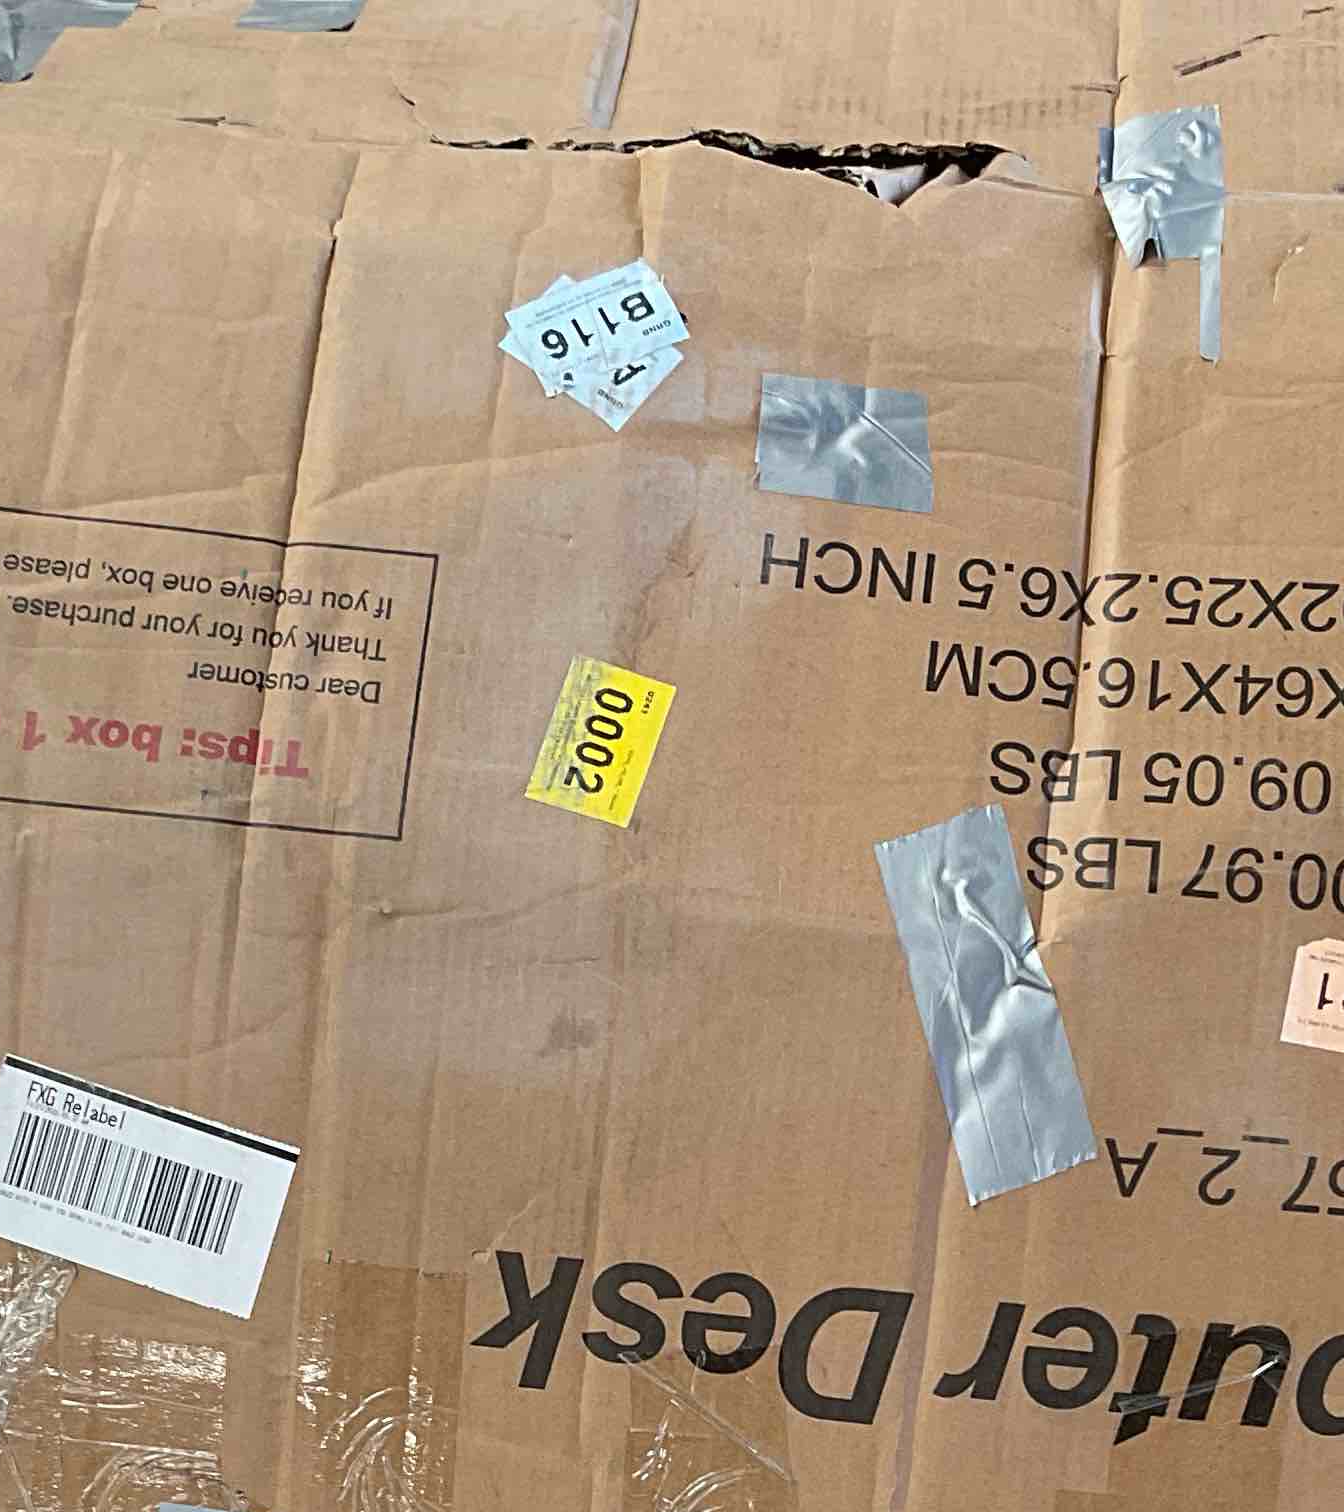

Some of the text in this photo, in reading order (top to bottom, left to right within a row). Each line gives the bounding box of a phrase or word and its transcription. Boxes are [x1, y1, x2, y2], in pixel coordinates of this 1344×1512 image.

[541, 291, 655, 359] B116
[3, 550, 91, 584] please
[101, 563, 154, 593] box,
[162, 573, 211, 596] one
[760, 533, 936, 606] INCH
[6, 594, 135, 632] purchase.
[221, 582, 313, 609] receive
[321, 589, 368, 612] you
[373, 597, 393, 620] If
[141, 613, 200, 638] your
[208, 621, 243, 647] for
[252, 625, 296, 647] you
[306, 632, 386, 661] Thank
[187, 662, 381, 705] Dear customer
[21, 711, 45, 751] 1
[64, 714, 163, 763] box
[564, 688, 633, 793] 0002
[176, 728, 309, 780] Tips:
[988, 741, 1120, 803] LBS
[1026, 836, 1161, 896] LBS
[27, 1080, 58, 1107] FXG
[63, 1092, 127, 1130] Relabel
[468, 1247, 913, 1428] Desk
